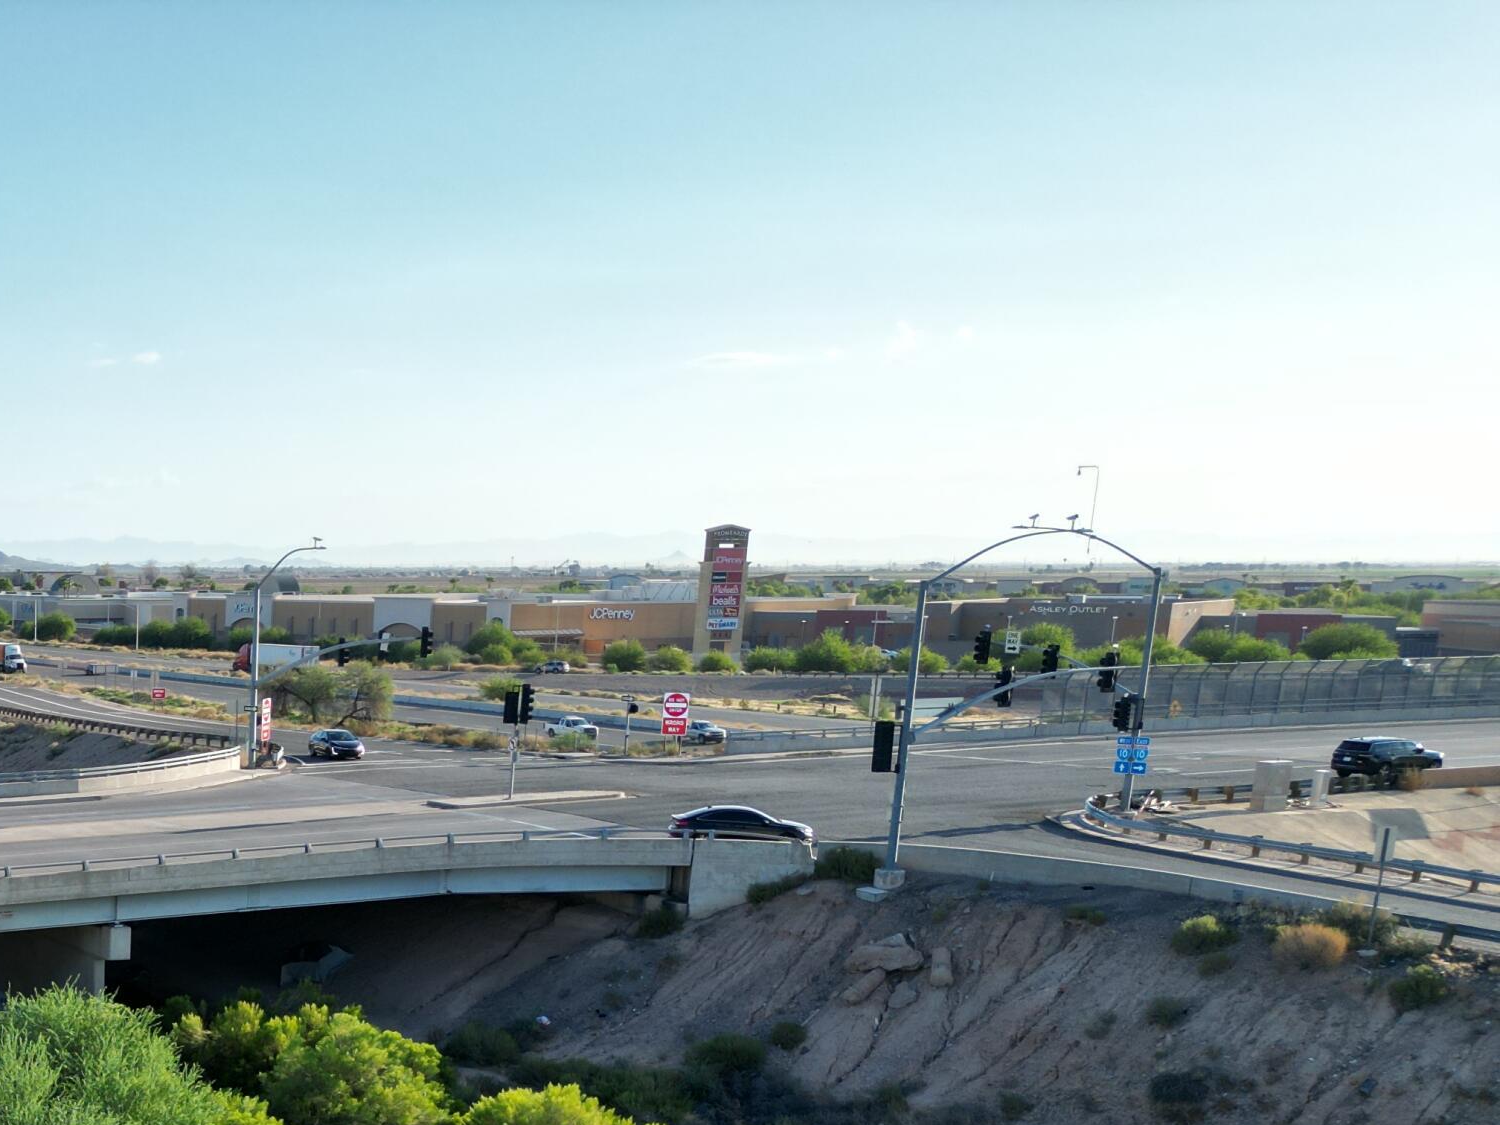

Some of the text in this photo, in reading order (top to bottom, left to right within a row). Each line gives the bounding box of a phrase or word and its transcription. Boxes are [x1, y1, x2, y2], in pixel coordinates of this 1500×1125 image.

[712, 596, 736, 605] bealls
[590, 607, 635, 621] JCPenney
[1119, 749, 1128, 758] 10
[1136, 750, 1146, 759] 10
